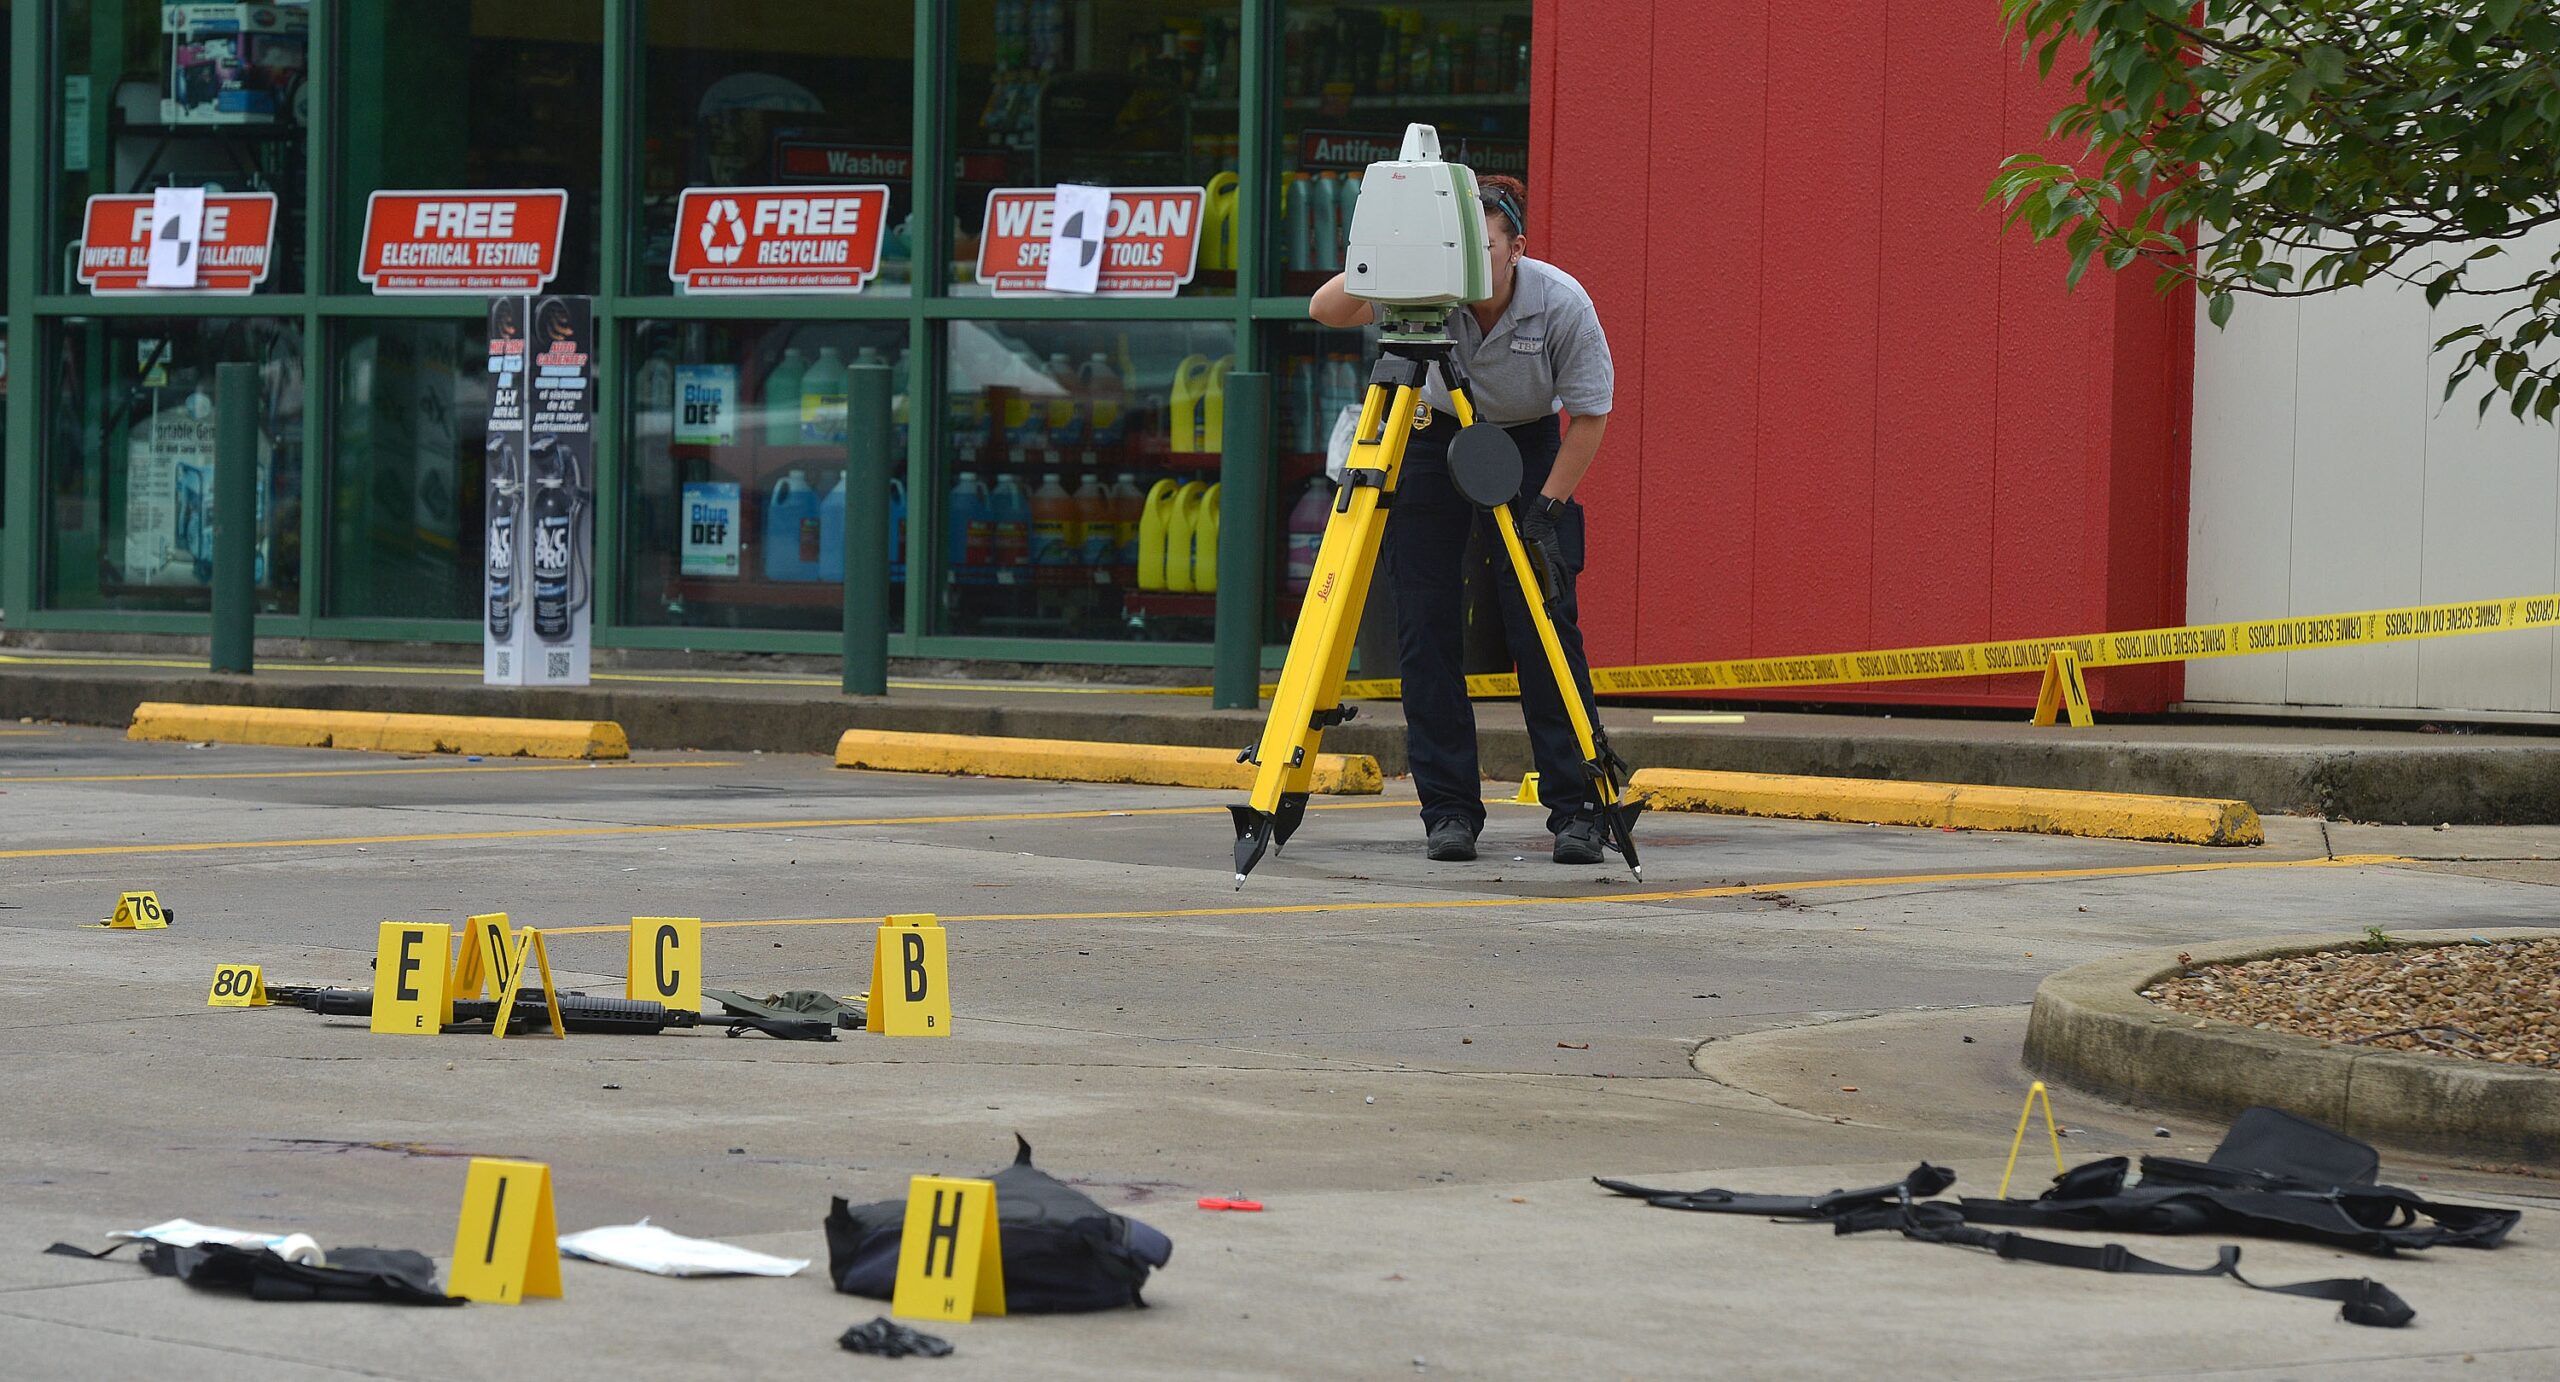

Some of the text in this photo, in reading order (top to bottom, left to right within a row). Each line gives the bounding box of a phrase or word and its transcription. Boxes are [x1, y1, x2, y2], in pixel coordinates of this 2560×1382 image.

[826, 151, 907, 176] Washer
[131, 206, 230, 243] FE
[414, 202, 517, 239] FREE
[752, 197, 861, 236] FREE
[996, 199, 1193, 238] WE OAN
[85, 246, 127, 267] WIPER
[130, 246, 153, 267] BLA
[381, 242, 541, 266] ELECTRICAL TESTING
[757, 240, 848, 265] RECYCLING
[1111, 243, 1163, 267] TOOLS
[1518, 342, 1536, 350] TBI
[684, 384, 722, 404] Blue
[684, 404, 720, 424] DEF
[691, 504, 728, 524] Blue
[535, 527, 567, 551] A/C
[691, 524, 727, 544] DEF
[535, 549, 567, 569] PRO
[1317, 572, 1335, 603] Leica
[2414, 610, 2431, 634] NOT
[2432, 609, 2445, 632] DO
[2446, 606, 2474, 631] SCENE
[2475, 603, 2502, 628] CRIME
[2525, 598, 2554, 624] CROSS
[2277, 623, 2293, 646] NOT
[2294, 621, 2306, 645] DO
[2309, 618, 2334, 643] SCENE
[2336, 616, 2362, 641] CRIME
[2385, 612, 2412, 637] CROSS
[2114, 636, 2142, 660] CROSS
[2144, 634, 2159, 657] NOT
[2160, 633, 2172, 656] DO
[2173, 631, 2199, 655] SCENE
[2200, 629, 2226, 652] CRIME
[2248, 625, 2275, 649] CROSS
[1856, 650, 1965, 677] CRIME SCENE DO NOT CROSS
[1984, 647, 2012, 669] CROSS
[2012, 645, 2029, 667] NOT
[2028, 644, 2041, 666] DO
[1731, 658, 1839, 684] CRIME SCENE DO NOT CROSS
[2065, 657, 2083, 706] K
[127, 896, 160, 920] 76
[396, 930, 423, 1001] E
[487, 924, 509, 994] D
[655, 924, 679, 996] C
[902, 933, 927, 1002] B
[214, 970, 252, 997] 80
[416, 1015, 423, 1028] E
[927, 1015, 935, 1028] B
[485, 1177, 507, 1264] I
[925, 1190, 963, 1278] H
[944, 1297, 954, 1313] H
